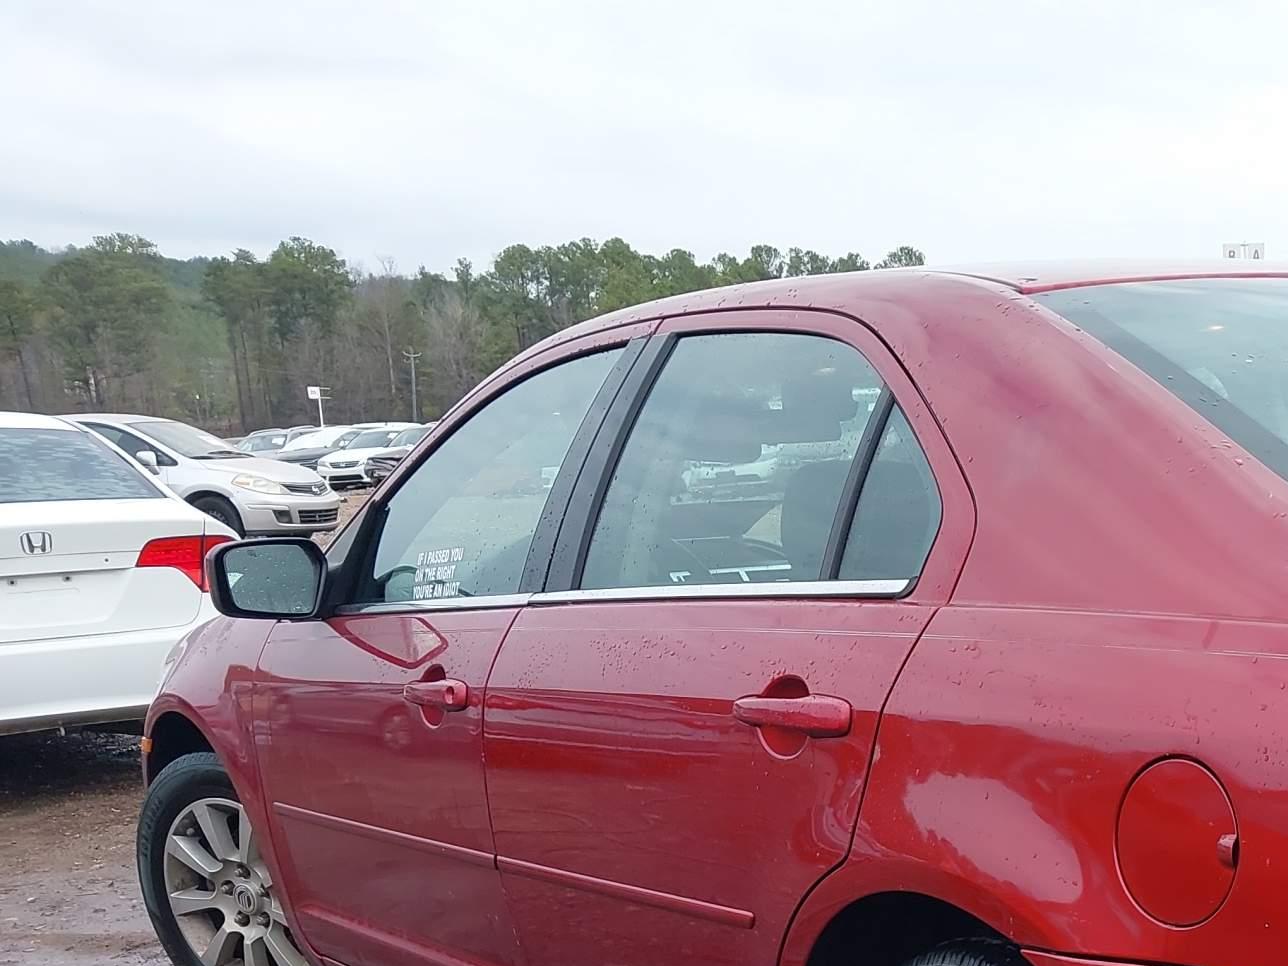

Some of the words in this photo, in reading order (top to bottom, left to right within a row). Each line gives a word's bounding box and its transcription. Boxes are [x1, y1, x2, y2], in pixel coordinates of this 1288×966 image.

[417, 552, 424, 566] IF
[427, 549, 450, 565] PASSED
[450, 548, 464, 561] YOU
[415, 567, 424, 582] ON
[424, 567, 436, 582] THE
[436, 565, 456, 580] RIGHT
[433, 583, 442, 597] AN
